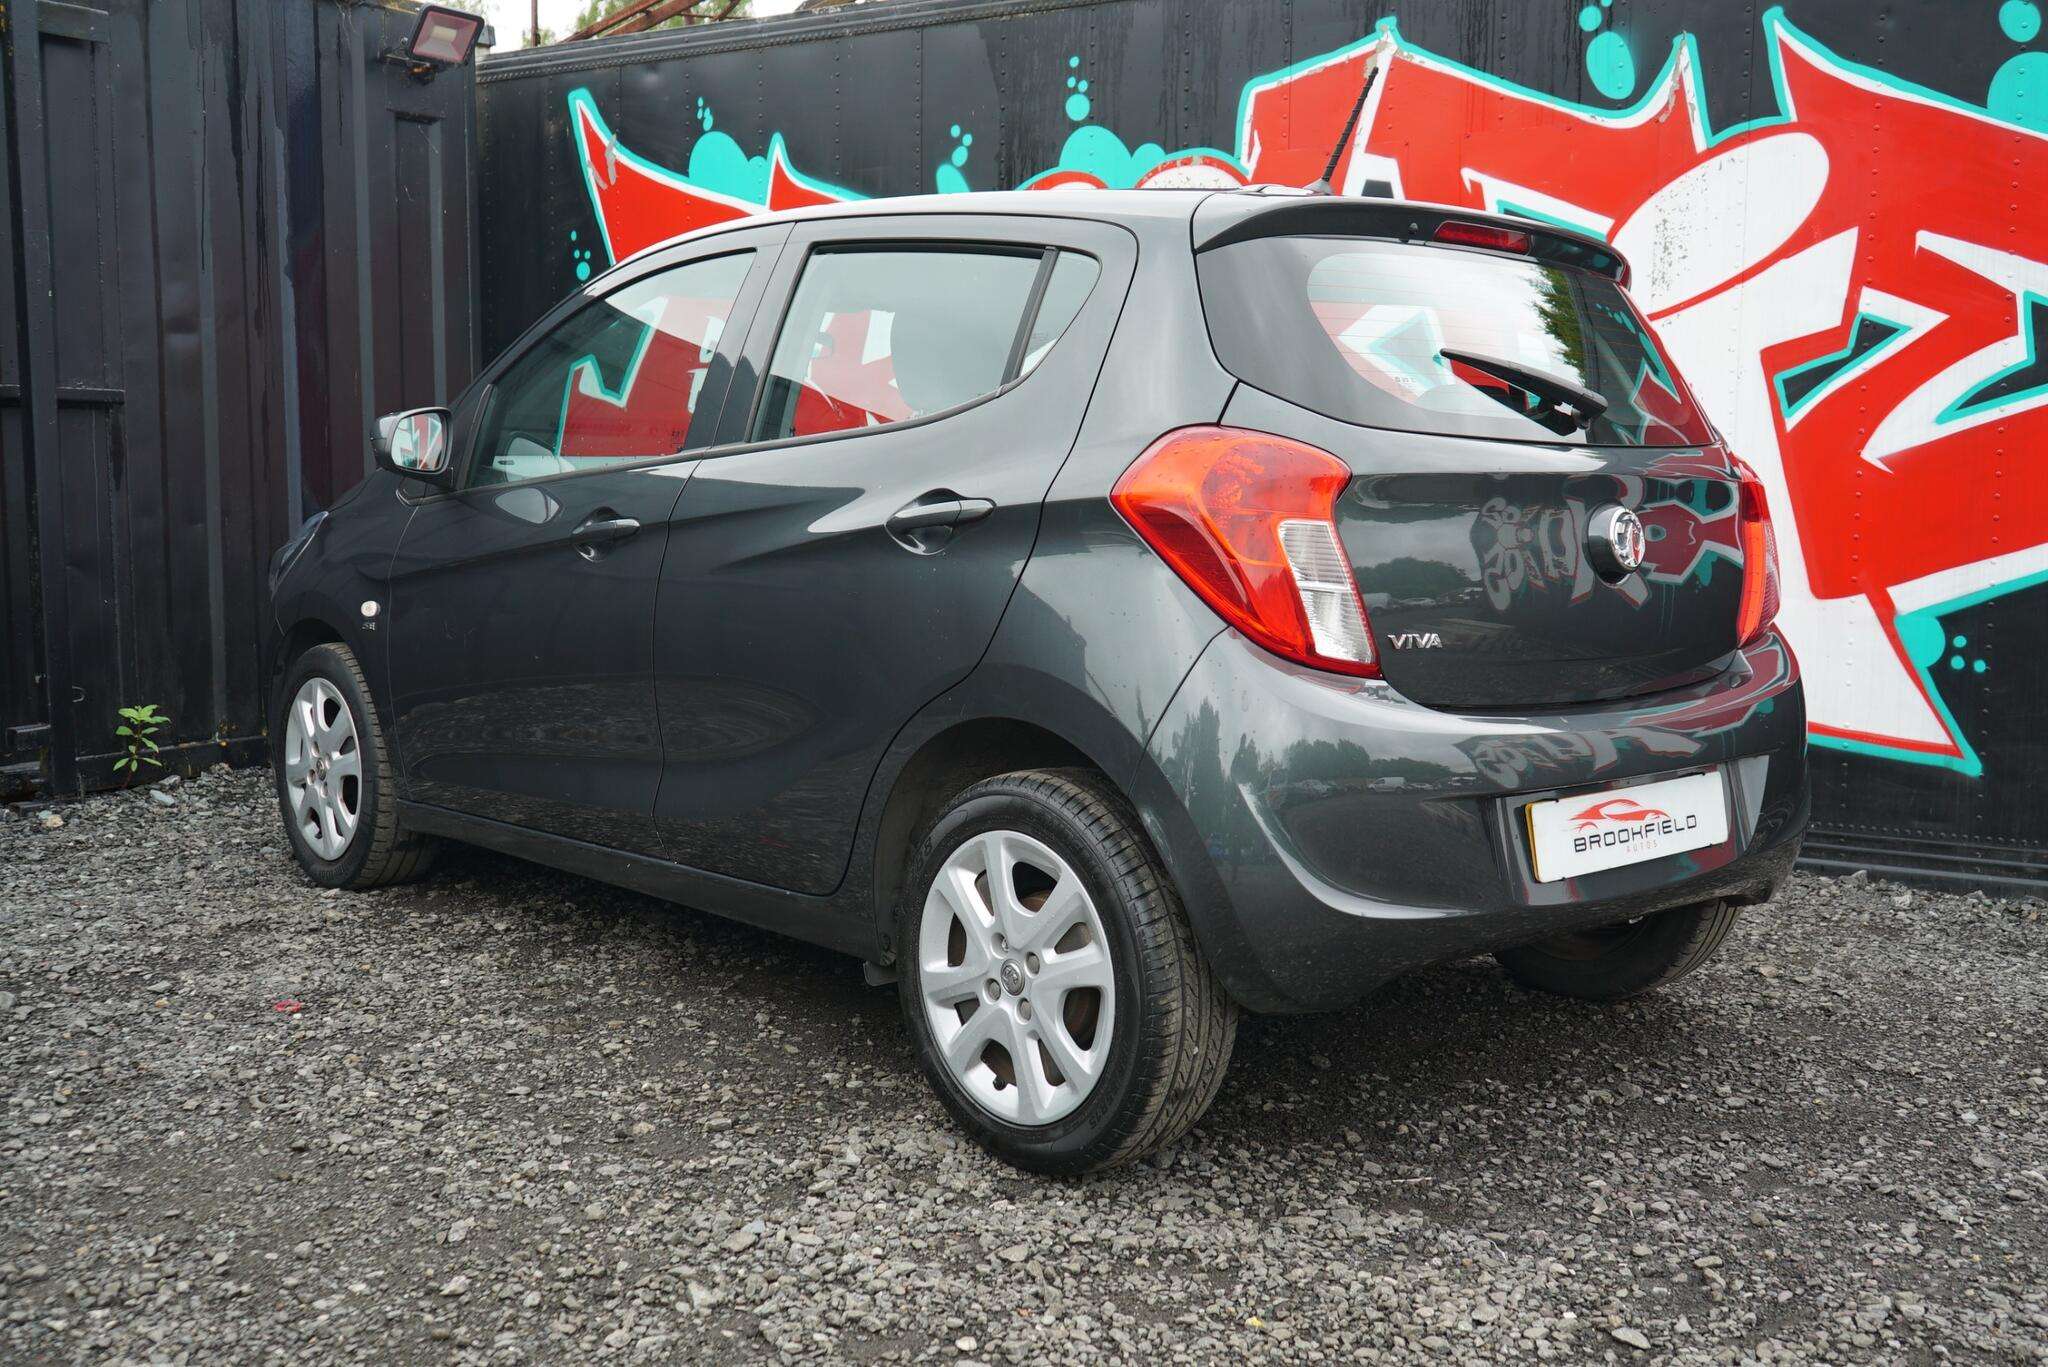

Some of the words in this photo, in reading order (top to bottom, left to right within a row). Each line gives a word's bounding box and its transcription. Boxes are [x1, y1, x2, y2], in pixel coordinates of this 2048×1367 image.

[1387, 633, 1443, 650] VIVA
[1574, 814, 1697, 853] BROOKFIELD
[1626, 840, 1658, 853] AUTOS
